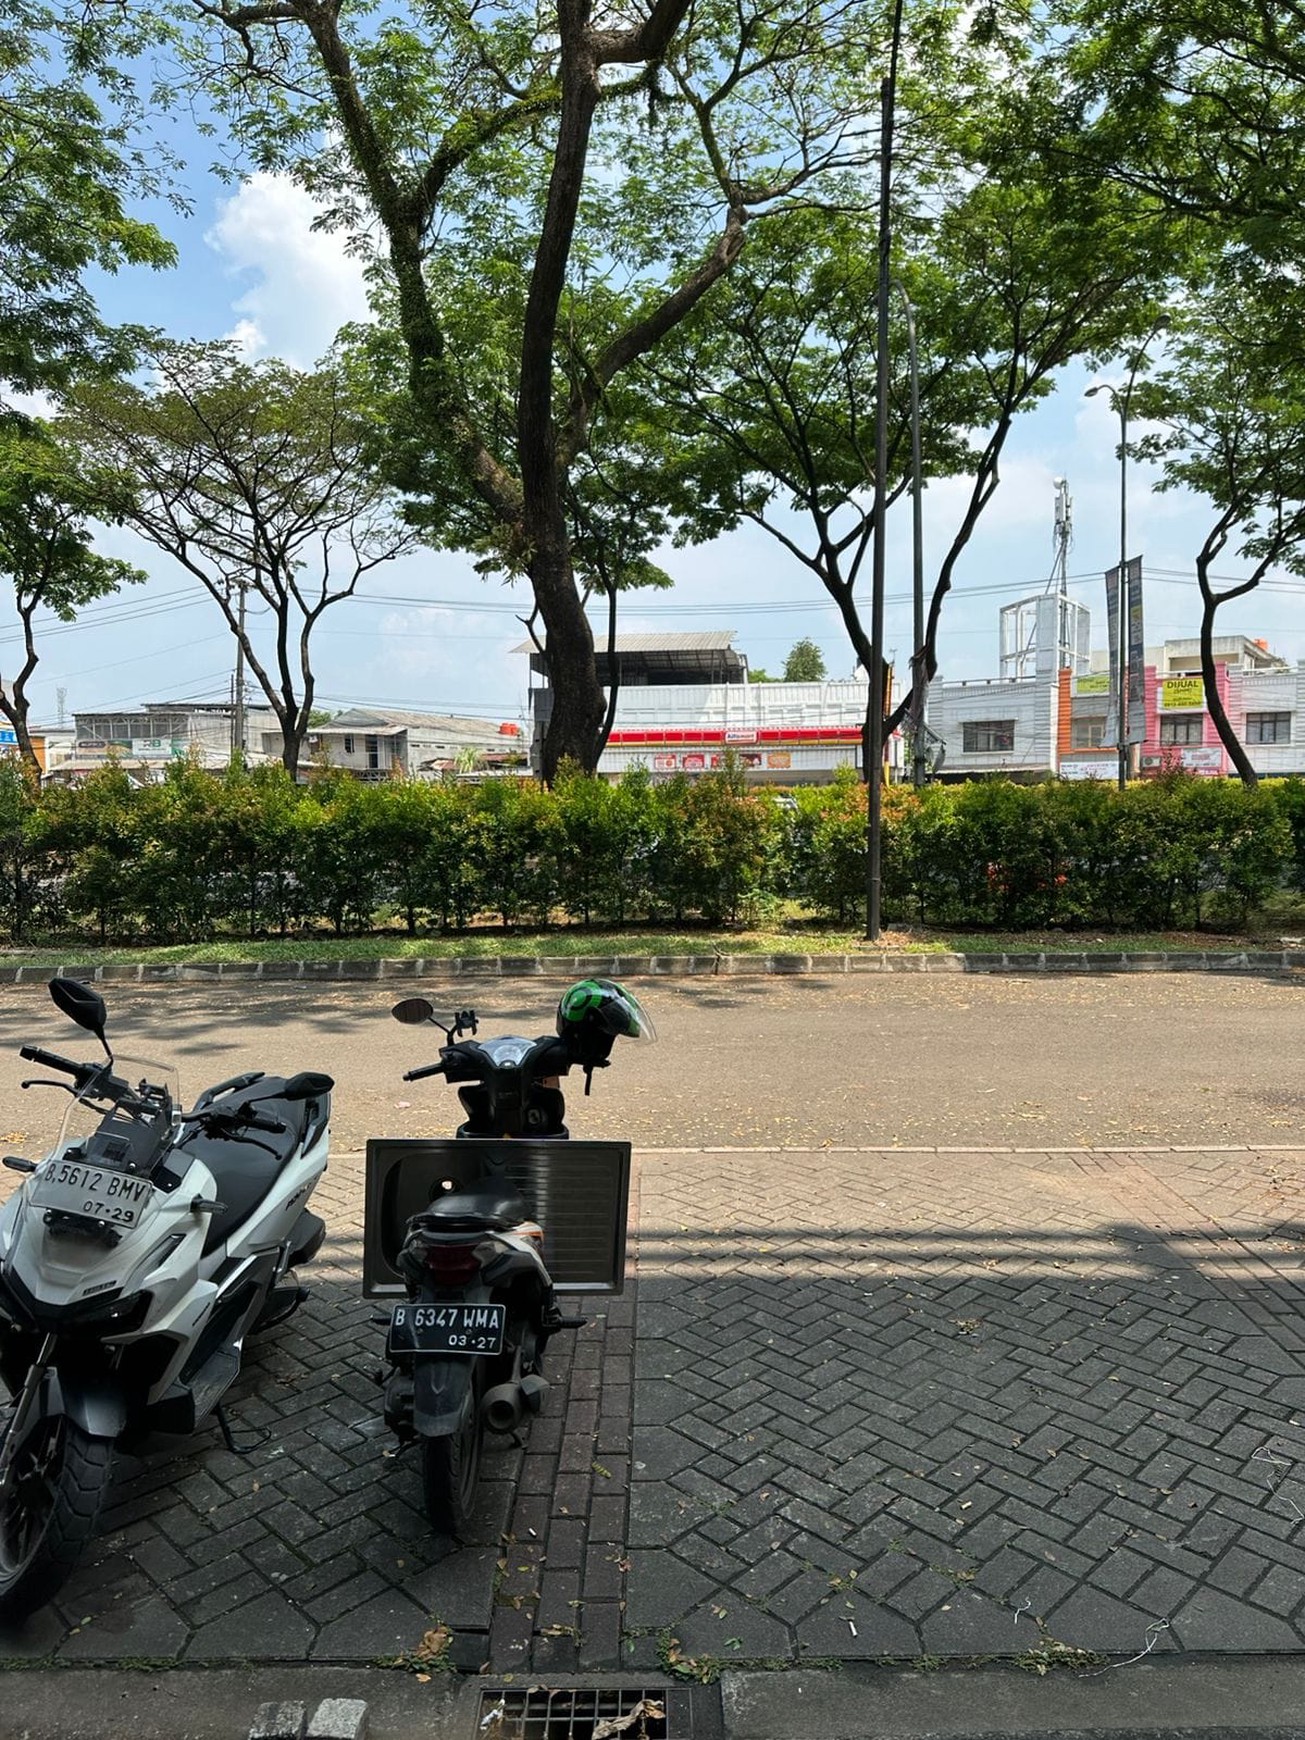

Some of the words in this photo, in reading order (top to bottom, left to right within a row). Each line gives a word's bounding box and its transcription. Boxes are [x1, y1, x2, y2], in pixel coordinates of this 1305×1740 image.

[45, 1163, 56, 1181] B
[58, 1164, 103, 1191] 5612
[107, 1176, 146, 1201] BMV
[395, 1308, 406, 1326] B
[414, 1308, 458, 1327] 6347
[463, 1309, 499, 1329] WMA
